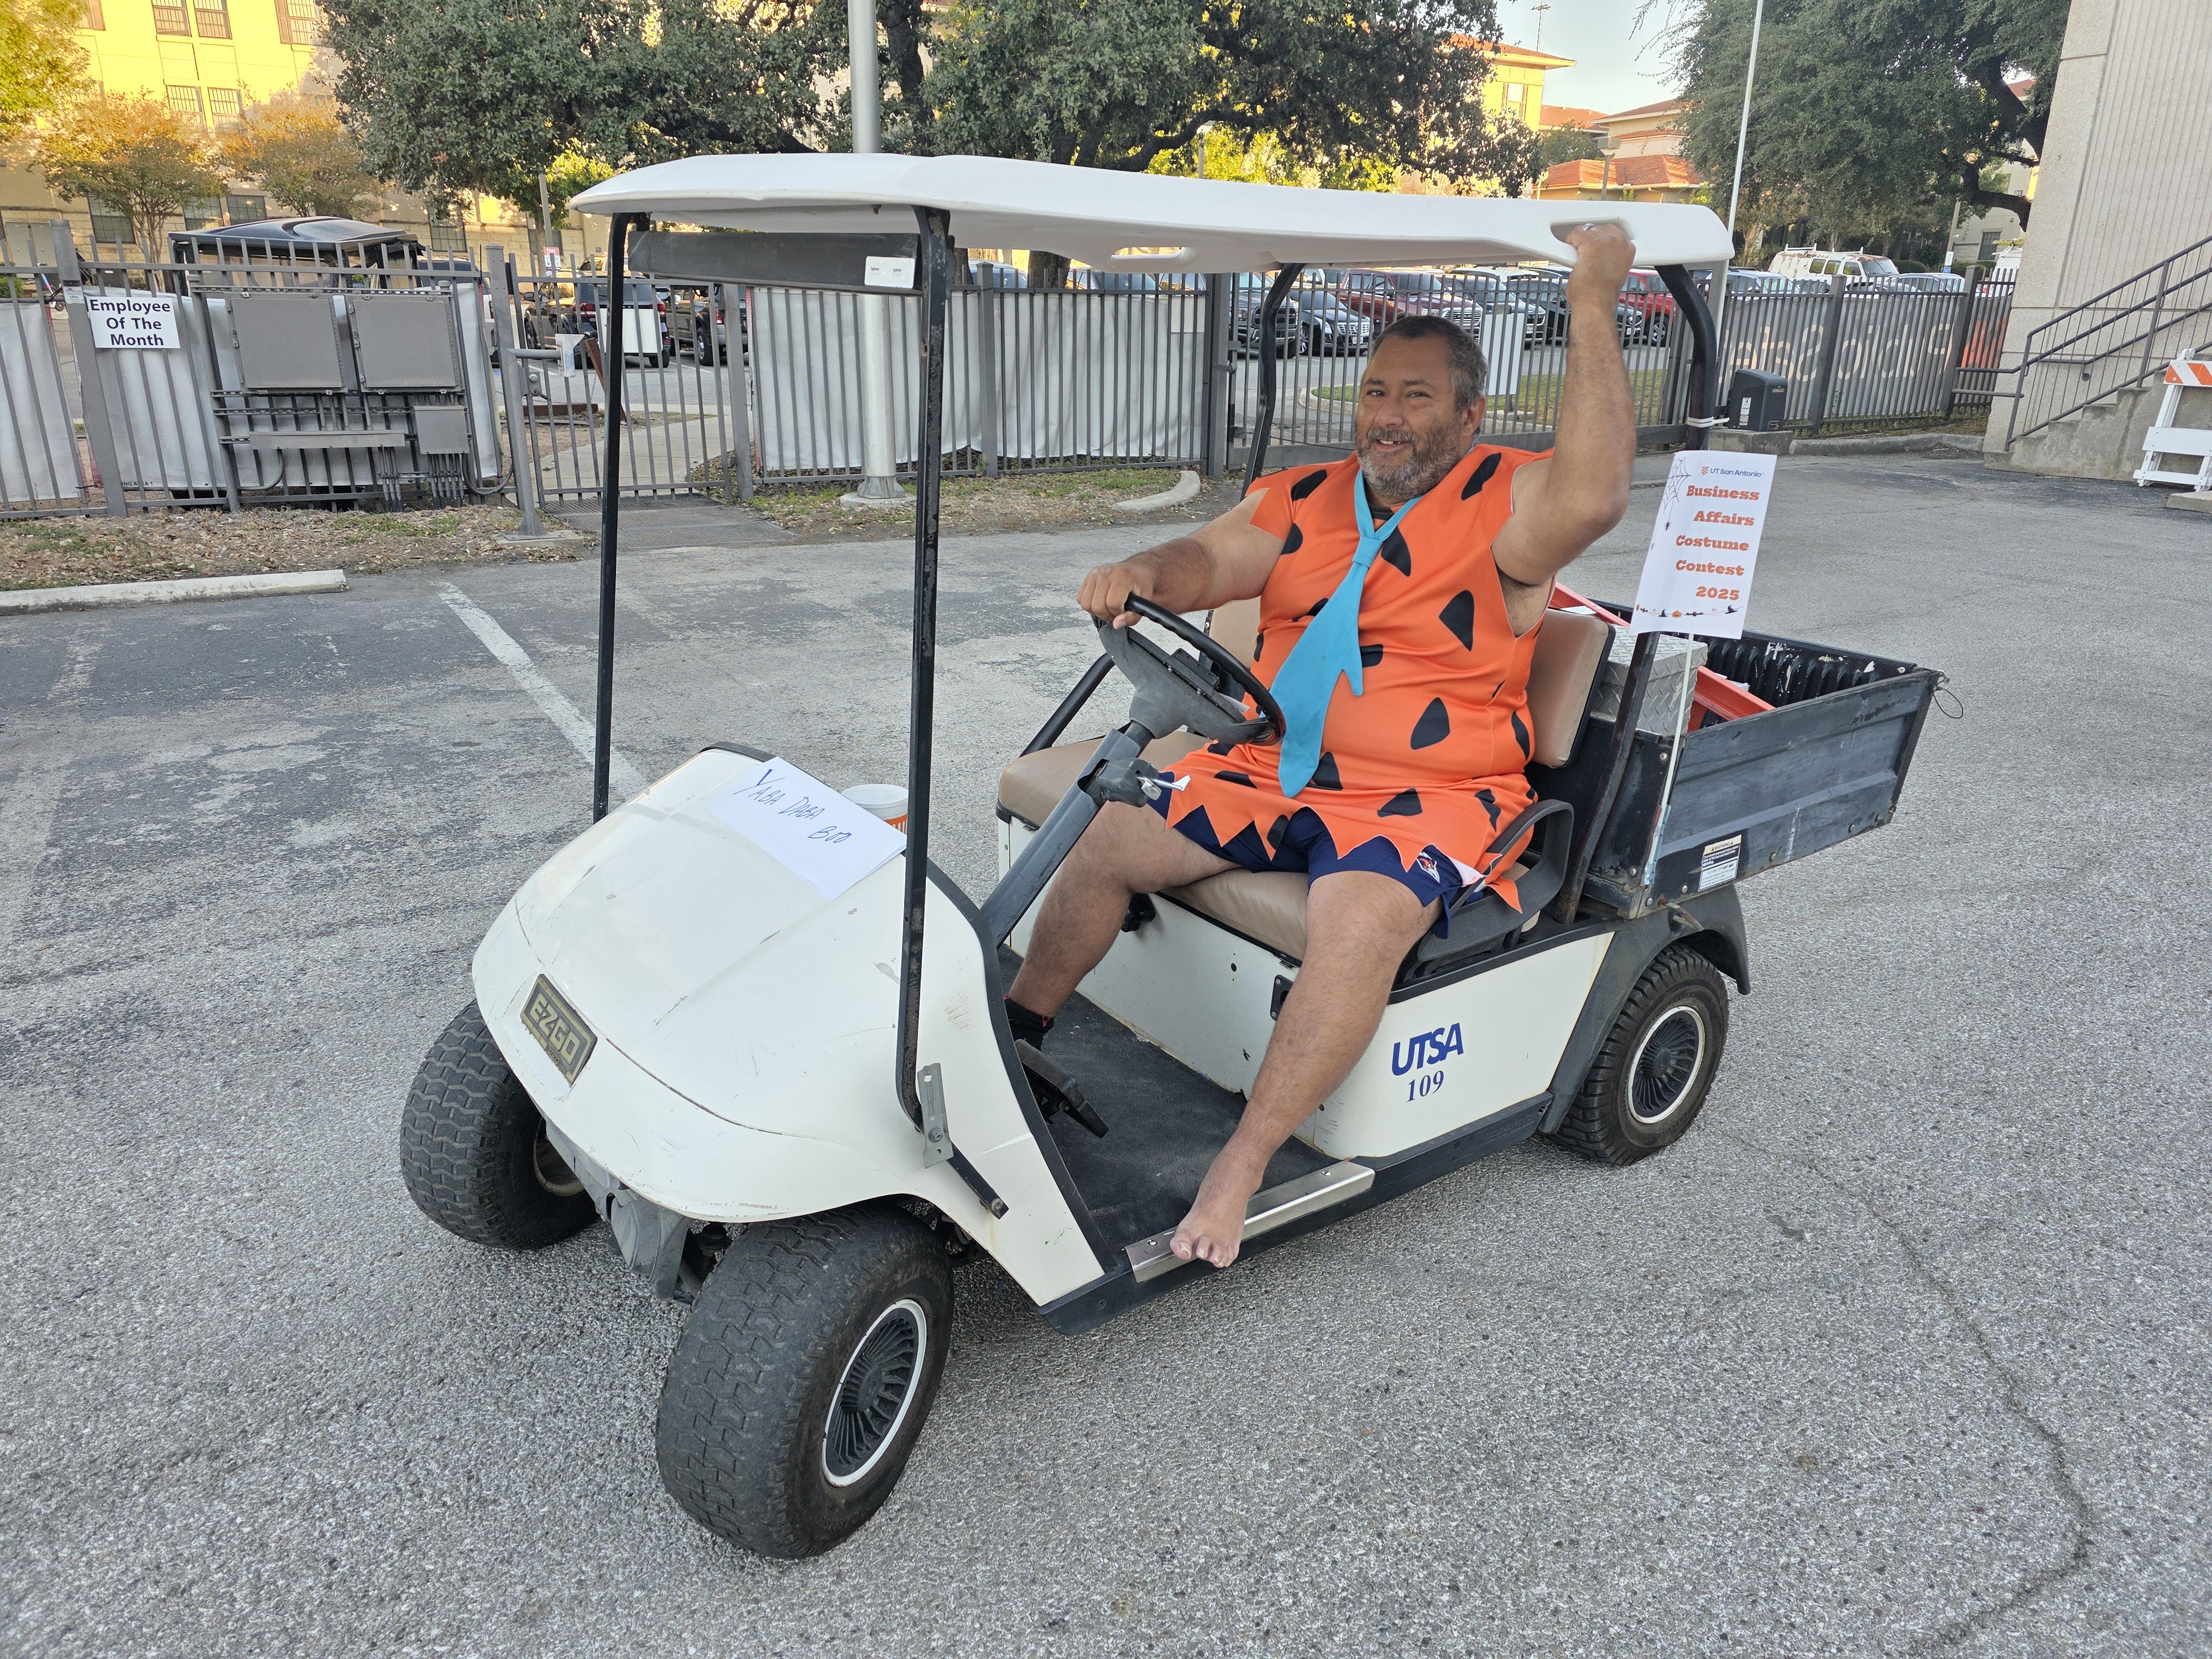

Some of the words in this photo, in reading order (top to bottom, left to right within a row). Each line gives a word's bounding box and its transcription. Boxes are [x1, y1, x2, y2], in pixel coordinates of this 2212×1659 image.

[90, 299, 170, 315] Employee
[106, 317, 126, 329] Of
[131, 317, 162, 330] The
[111, 333, 164, 346] Month
[1687, 485, 1760, 500] Business
[1694, 510, 1755, 526] Affairs
[1676, 535, 1750, 551] Costume
[1676, 560, 1745, 576] Contest
[1695, 586, 1740, 601] 2025
[733, 769, 786, 806] YABA
[778, 796, 826, 820] DABA
[807, 826, 853, 843] BOO
[1714, 841, 1730, 850] WARNING
[1392, 1022, 1464, 1076] UTSA
[1406, 1070, 1444, 1103] 109
